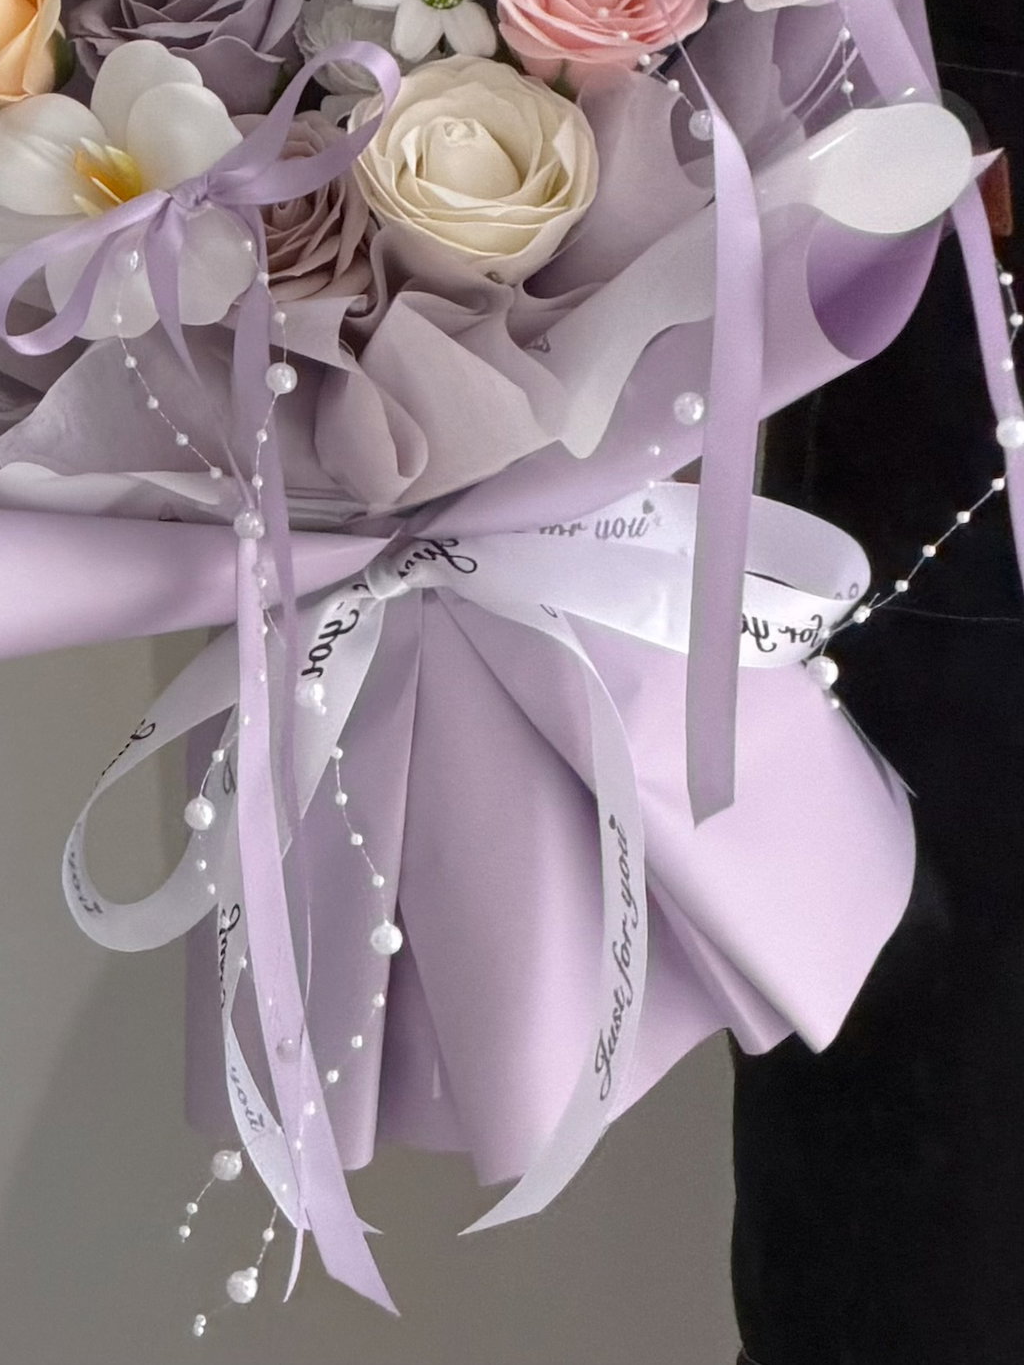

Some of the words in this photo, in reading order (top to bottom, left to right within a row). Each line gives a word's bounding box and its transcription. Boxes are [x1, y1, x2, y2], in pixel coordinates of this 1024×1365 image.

[612, 823, 639, 929] you
[612, 913, 634, 1008] for
[593, 985, 626, 1102] Just
